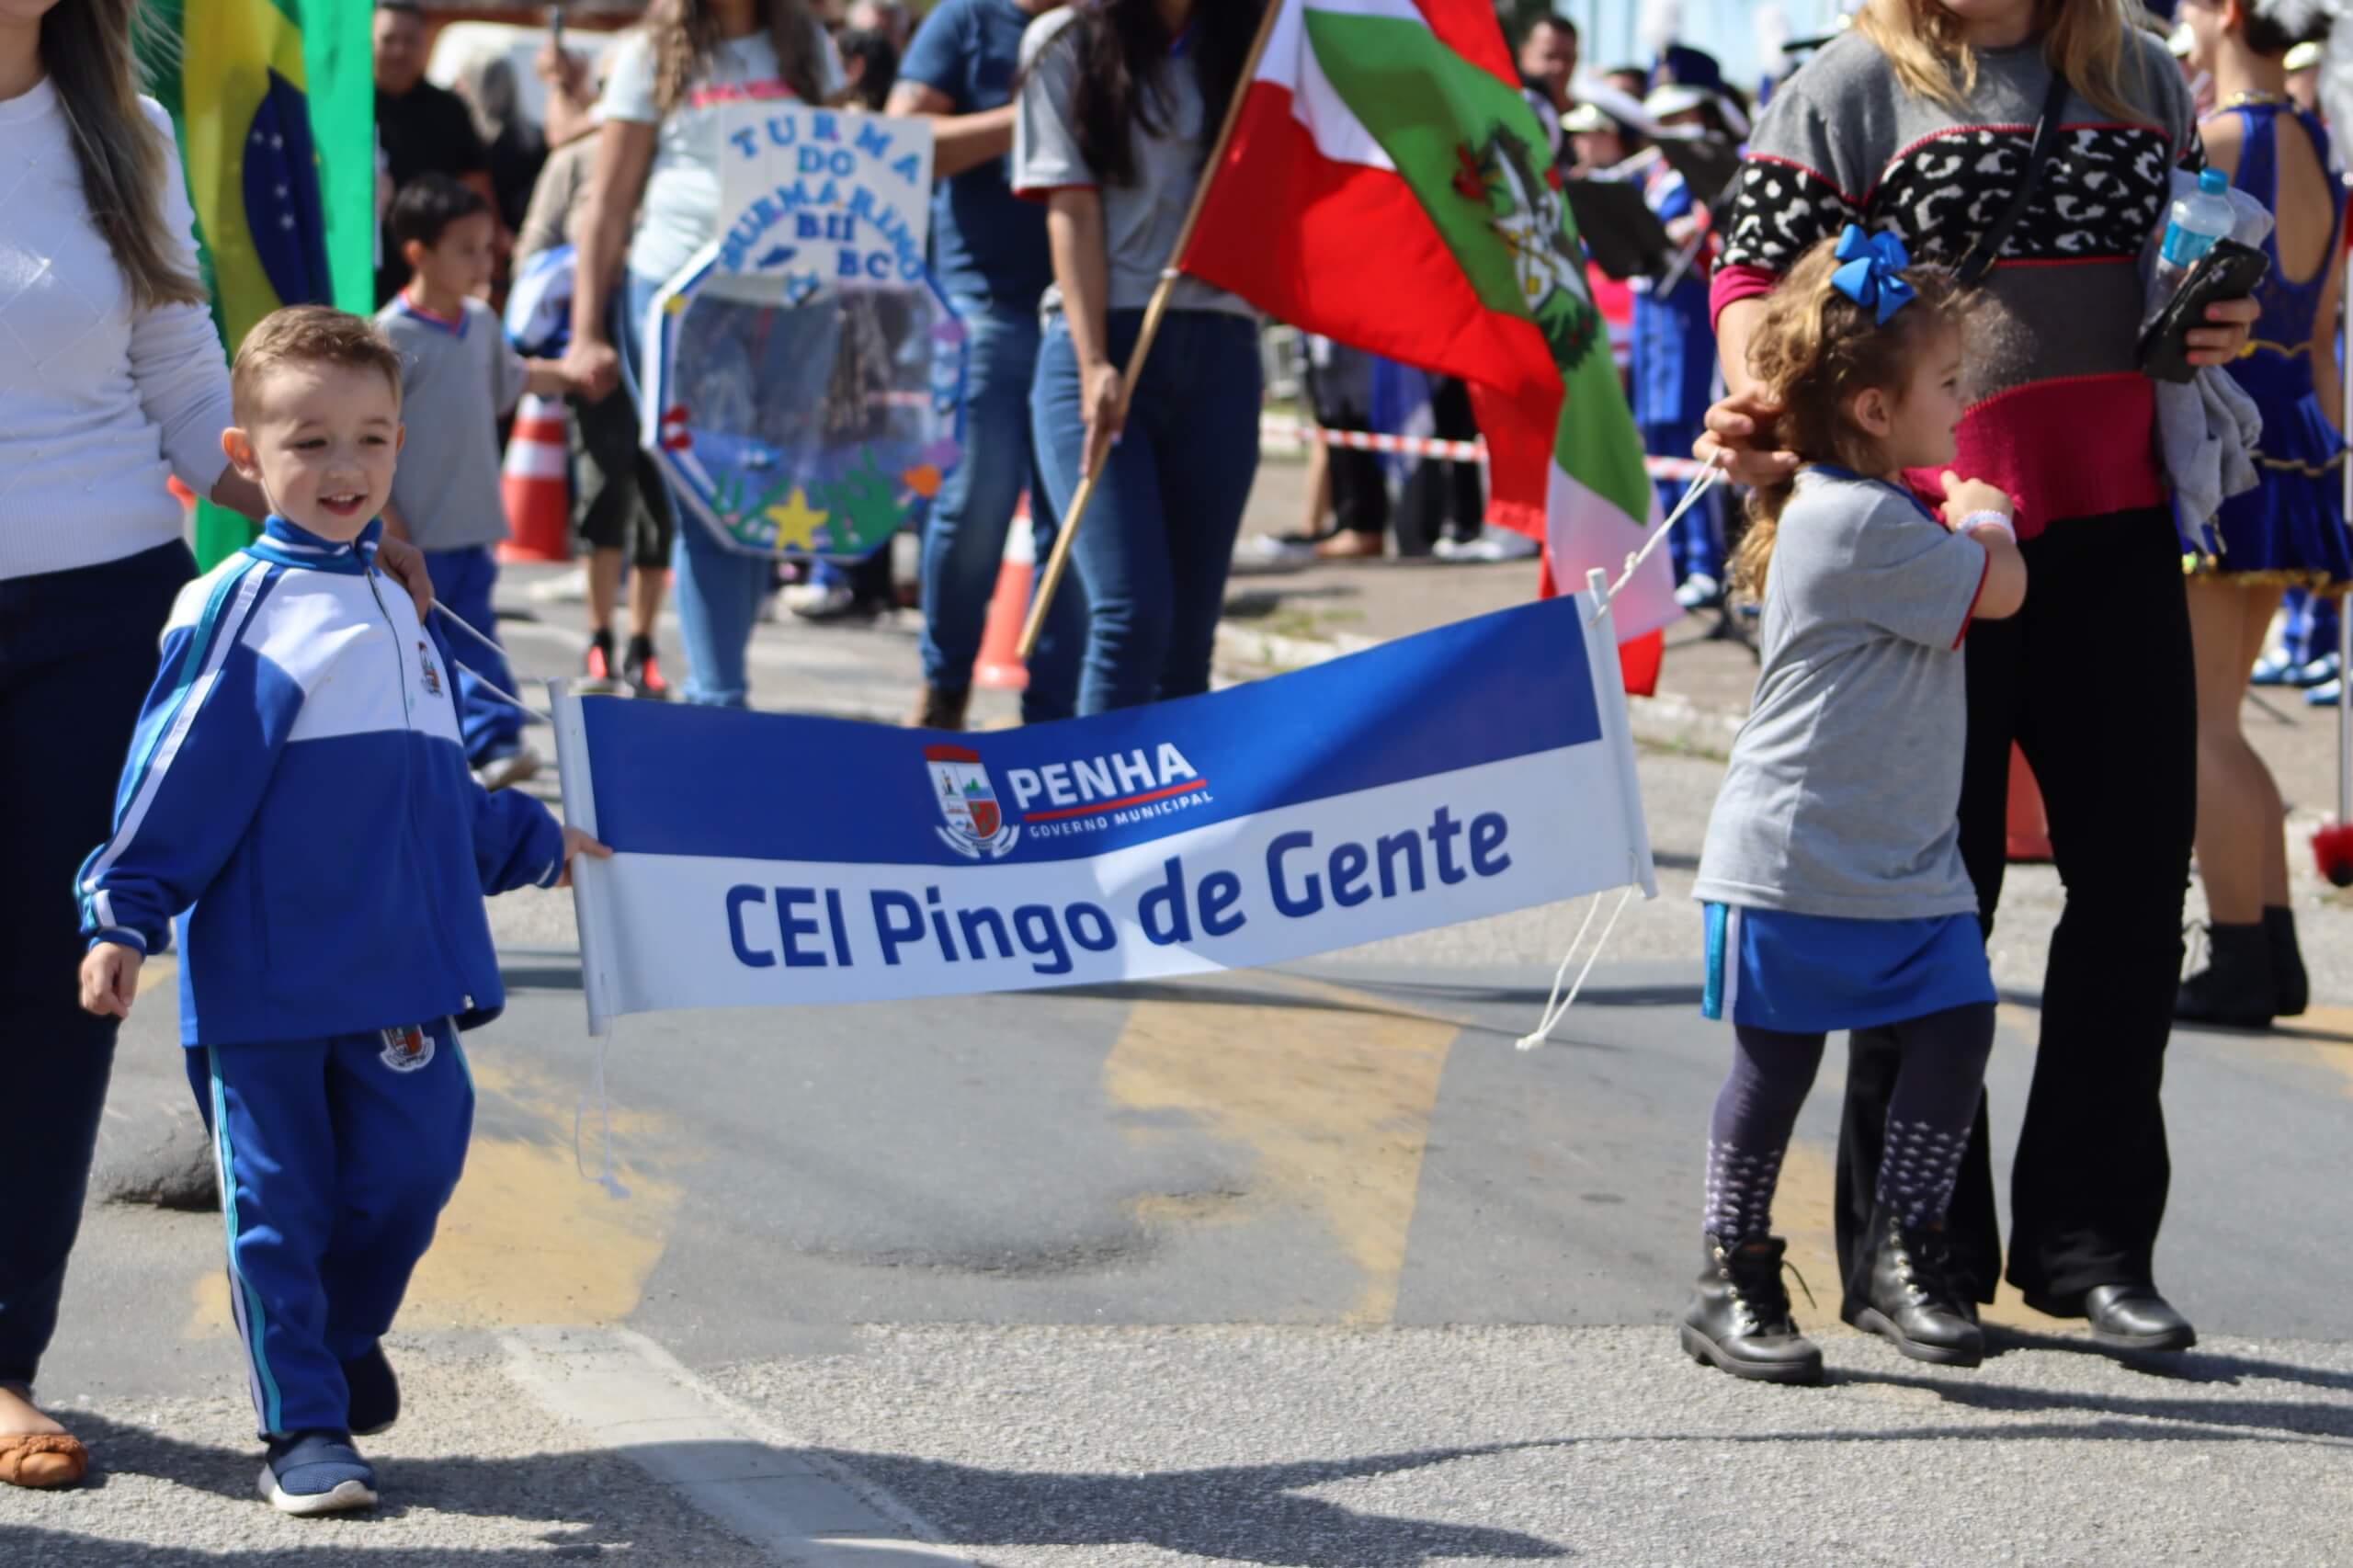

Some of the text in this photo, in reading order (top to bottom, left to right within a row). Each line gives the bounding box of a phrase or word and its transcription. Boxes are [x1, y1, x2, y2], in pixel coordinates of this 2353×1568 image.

[730, 112, 920, 184] TURMA
[798, 145, 855, 177] DO
[1007, 742, 1199, 810] PENHA
[1029, 790, 1214, 838] GOVERNO MUNICIPAL
[725, 805, 1511, 974] CEI Pingo de Gente
